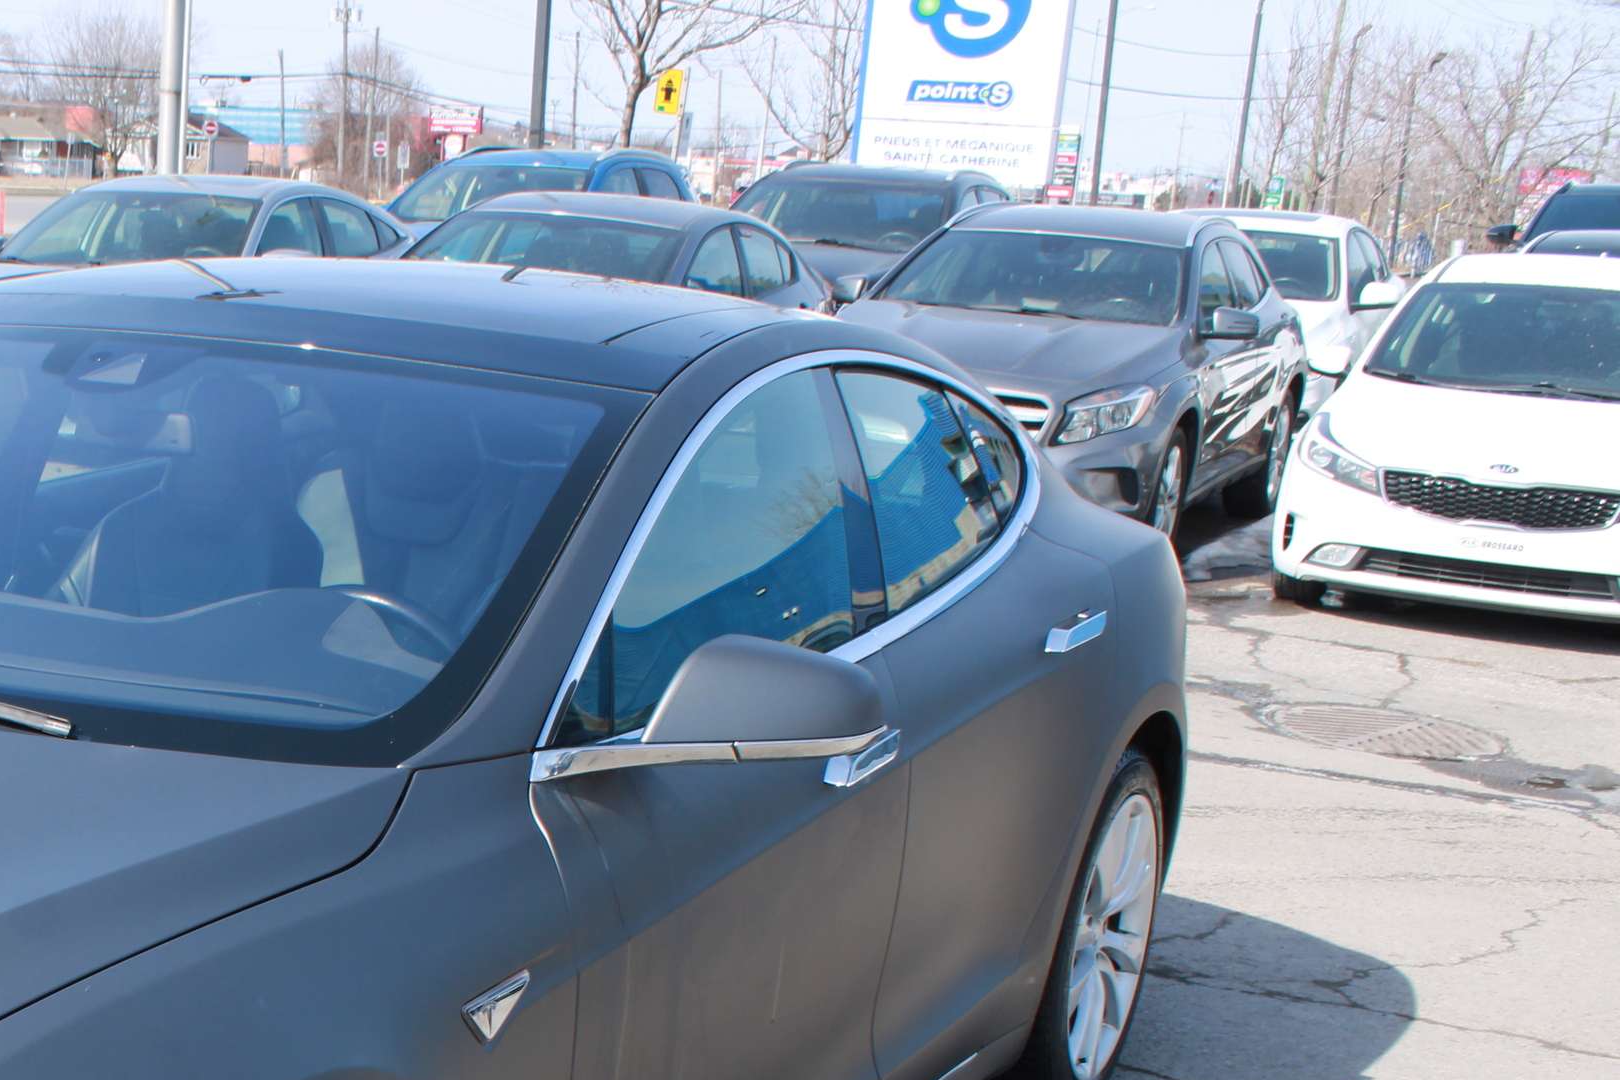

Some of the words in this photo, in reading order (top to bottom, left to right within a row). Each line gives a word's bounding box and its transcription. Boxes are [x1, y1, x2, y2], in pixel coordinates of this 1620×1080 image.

[913, 82, 978, 101] point
[874, 135, 920, 147] PNEUS
[924, 138, 941, 149] ET
[939, 153, 1021, 168] CATHERINE
